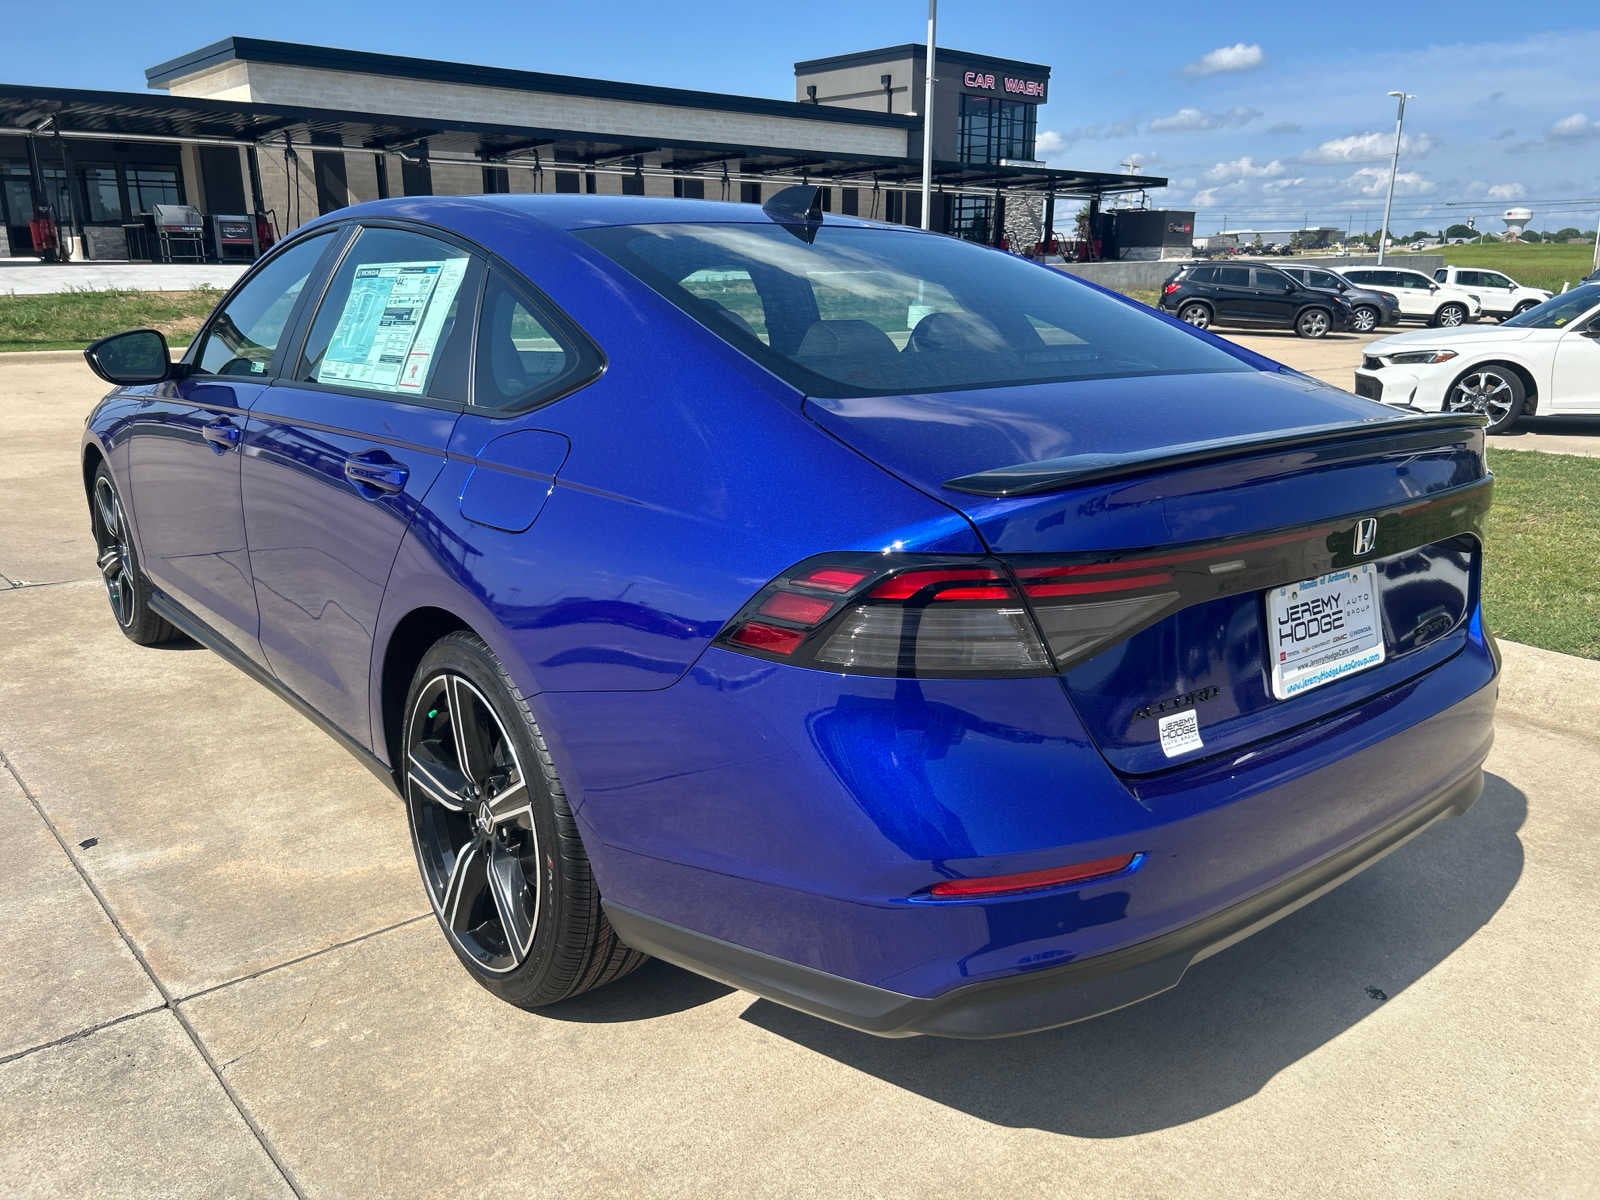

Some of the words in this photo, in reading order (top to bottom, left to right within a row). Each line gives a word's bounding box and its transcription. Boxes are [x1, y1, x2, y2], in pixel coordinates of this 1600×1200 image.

[964, 71, 995, 90] CAR
[1004, 77, 1044, 97] WASH
[1278, 592, 1341, 625] JEREMY
[1347, 593, 1369, 606] AUTO
[1279, 609, 1345, 646] HODGE
[1161, 715, 1195, 733] JEREMY
